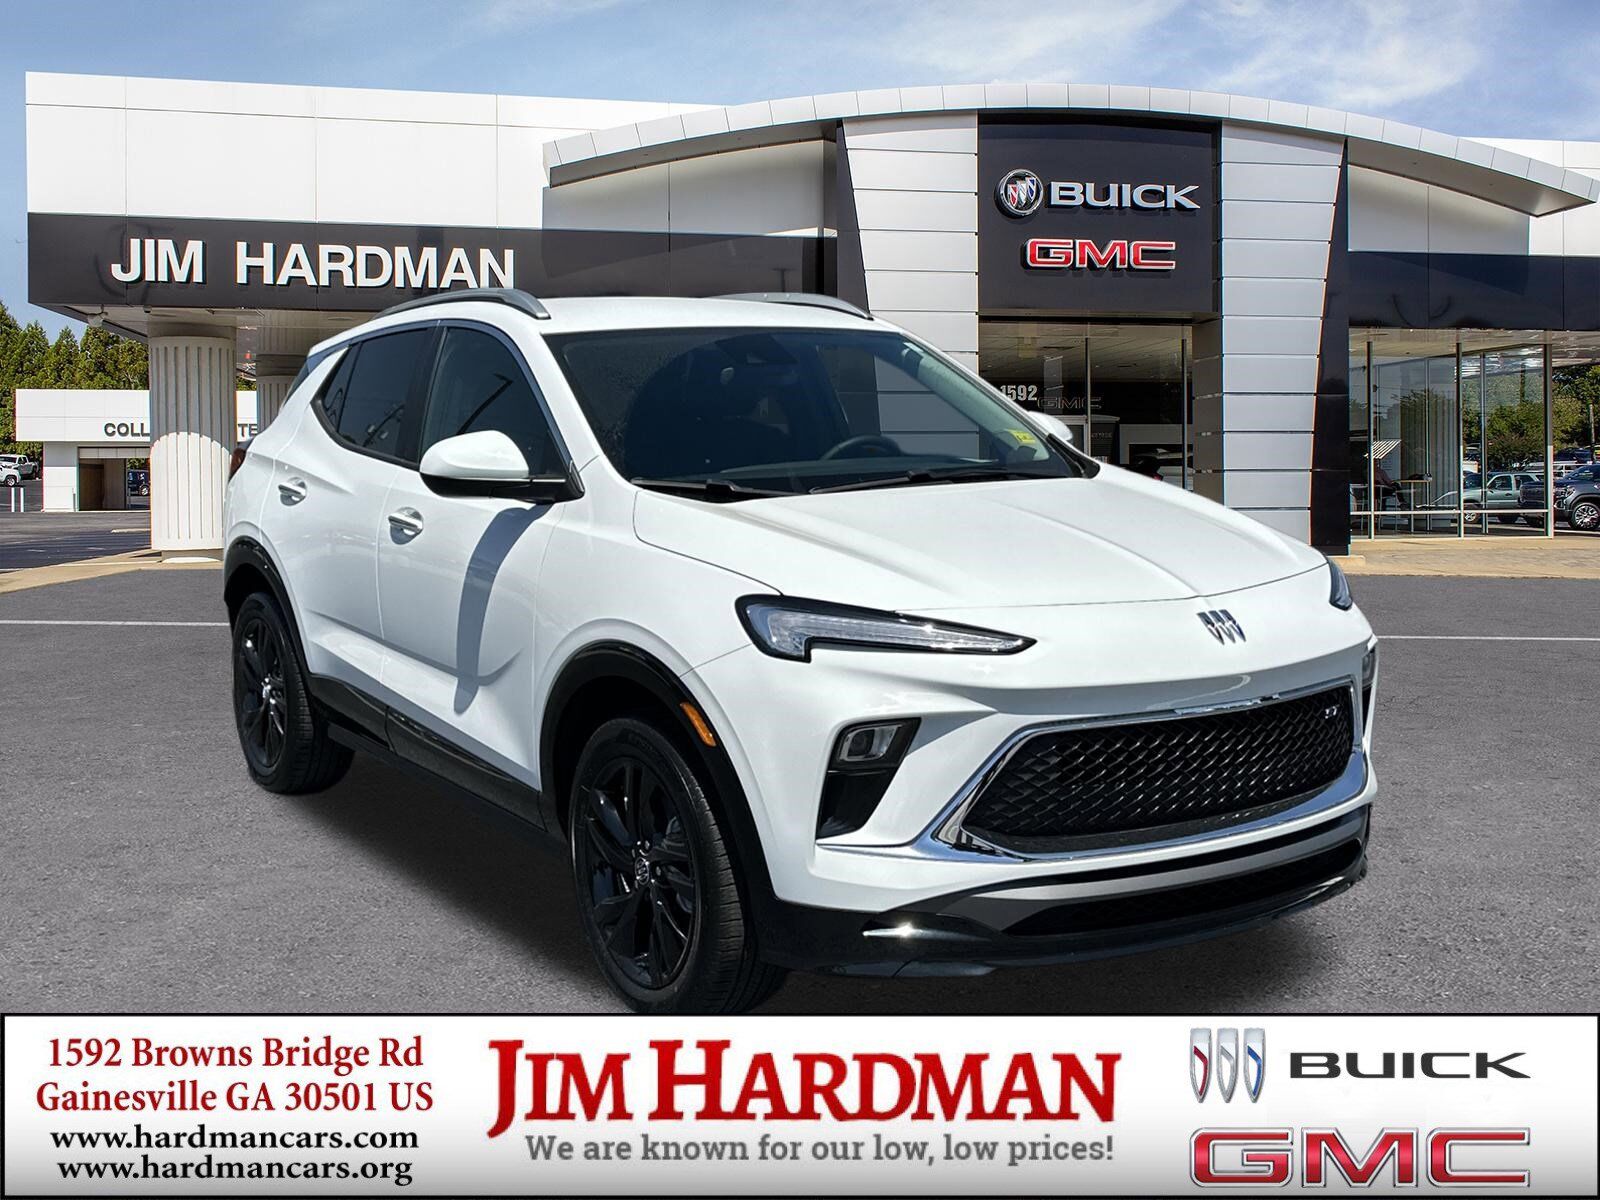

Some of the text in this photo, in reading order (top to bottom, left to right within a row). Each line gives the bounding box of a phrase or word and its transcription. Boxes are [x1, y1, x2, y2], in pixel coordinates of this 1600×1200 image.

[1051, 181, 1200, 209] BUICK
[111, 237, 515, 290] JIM HARDMAN
[1026, 238, 1176, 270] GMC
[1000, 384, 1038, 401] 1592
[104, 422, 150, 437] COLL
